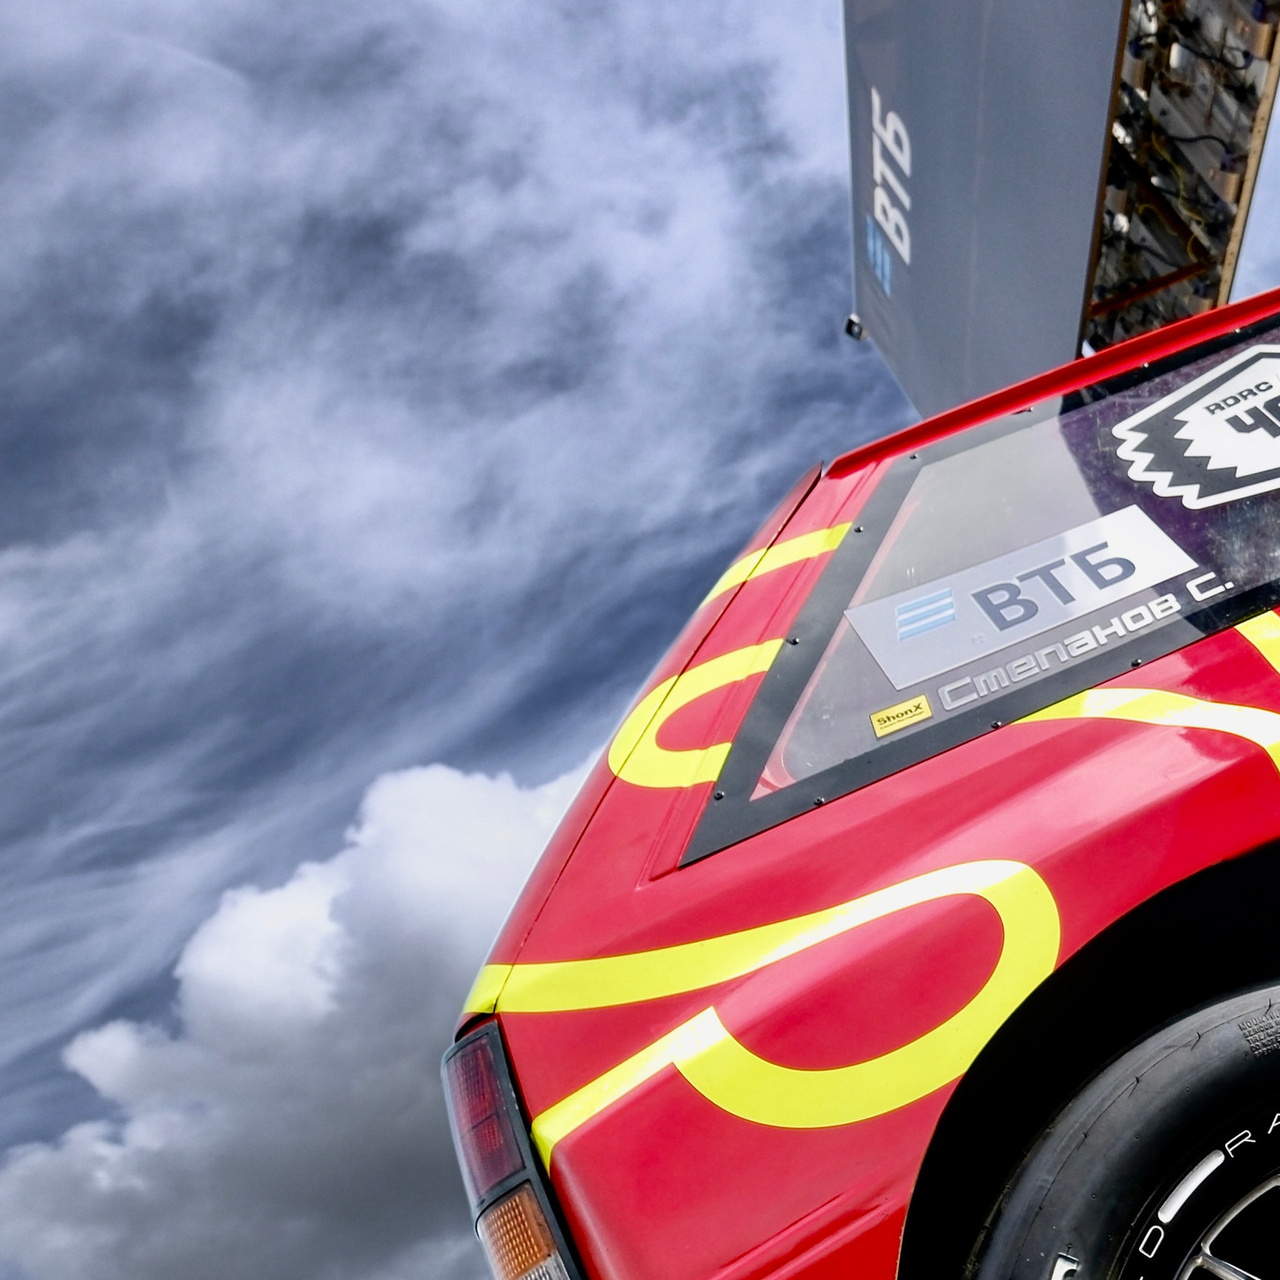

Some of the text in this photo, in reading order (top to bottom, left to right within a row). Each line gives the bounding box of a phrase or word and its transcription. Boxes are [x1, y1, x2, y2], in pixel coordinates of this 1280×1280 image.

[870, 86, 912, 266] ВТБ
[1204, 380, 1274, 416] RDRC
[969, 540, 1137, 633] ВТБ
[876, 701, 925, 727] ShonX
